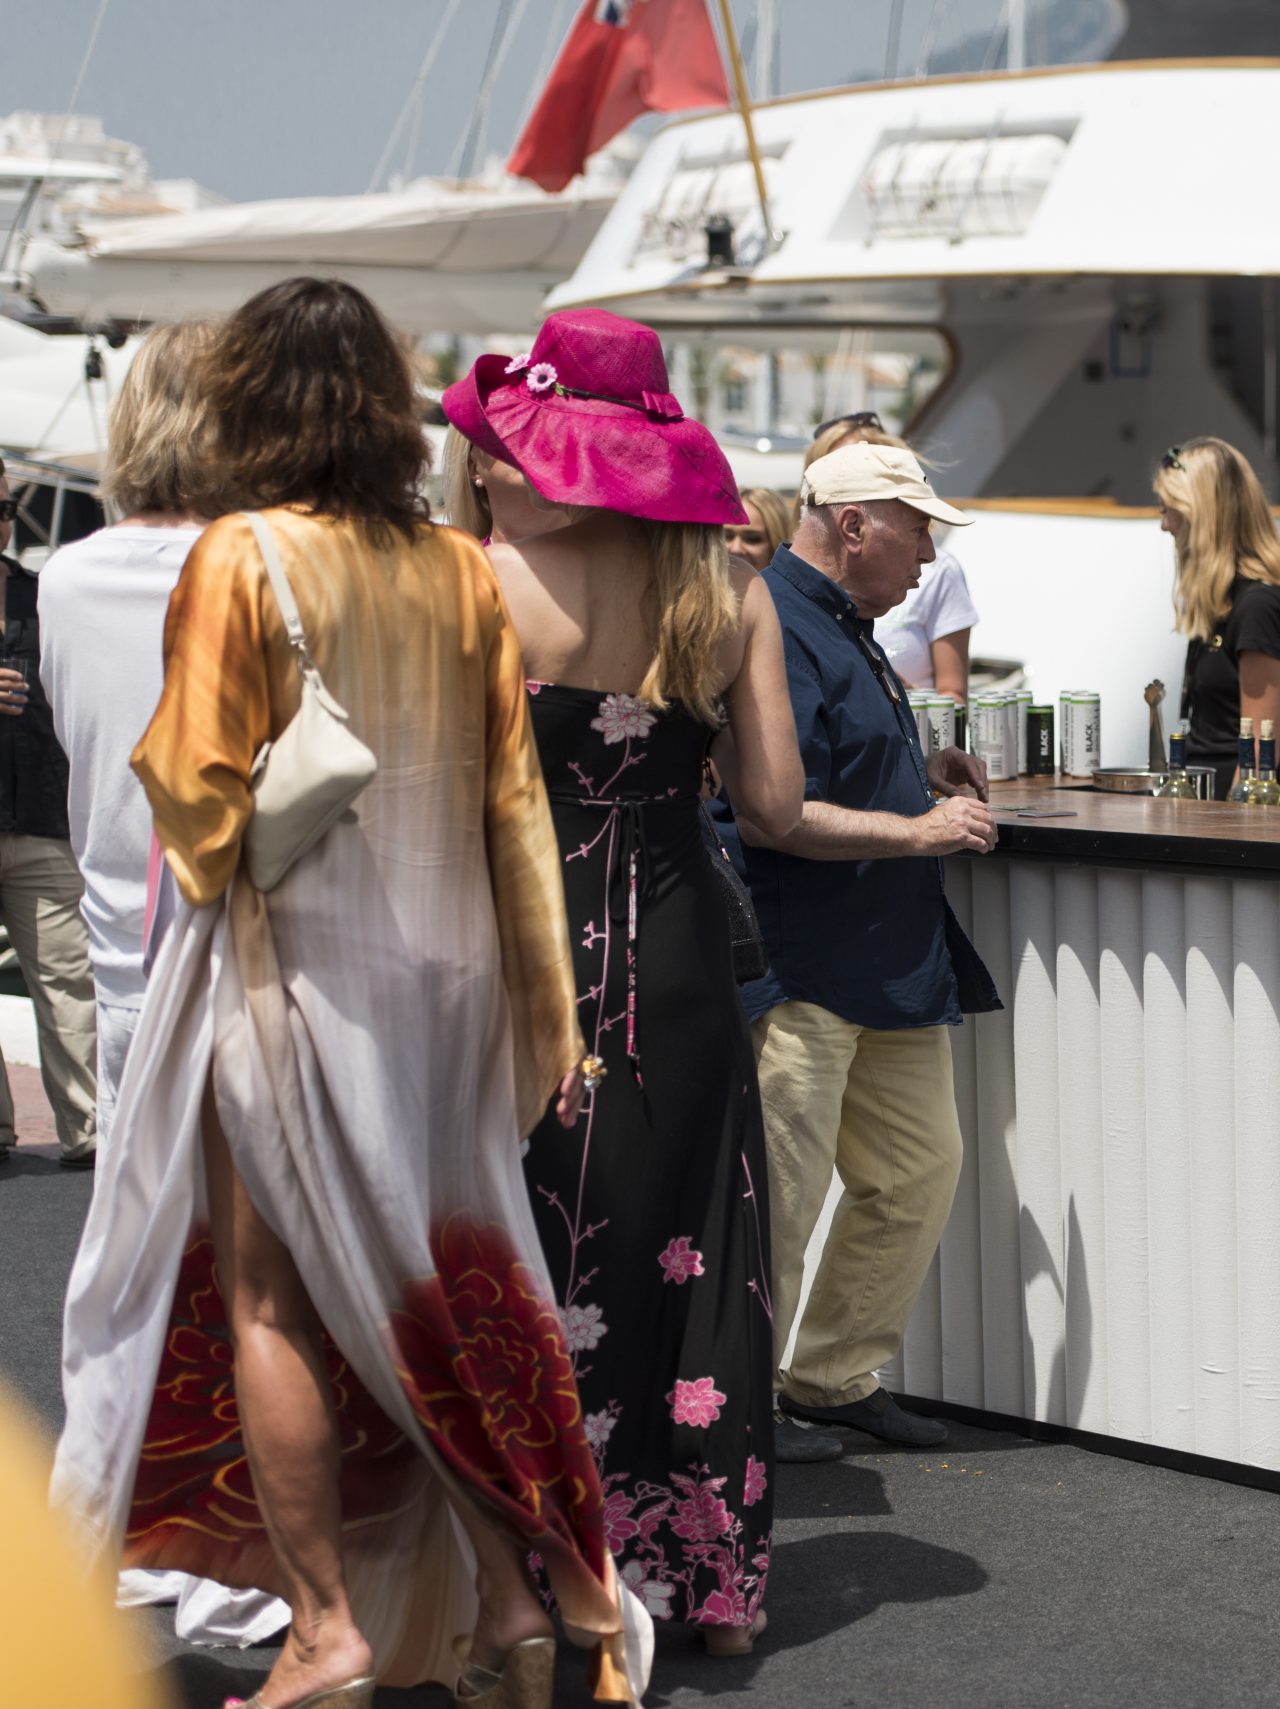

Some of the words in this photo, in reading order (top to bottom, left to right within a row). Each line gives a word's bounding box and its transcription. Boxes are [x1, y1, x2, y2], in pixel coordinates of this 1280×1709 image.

[932, 728, 940, 752] LACK
[1040, 729, 1049, 756] BLACK
[1085, 723, 1093, 752] BLACK
